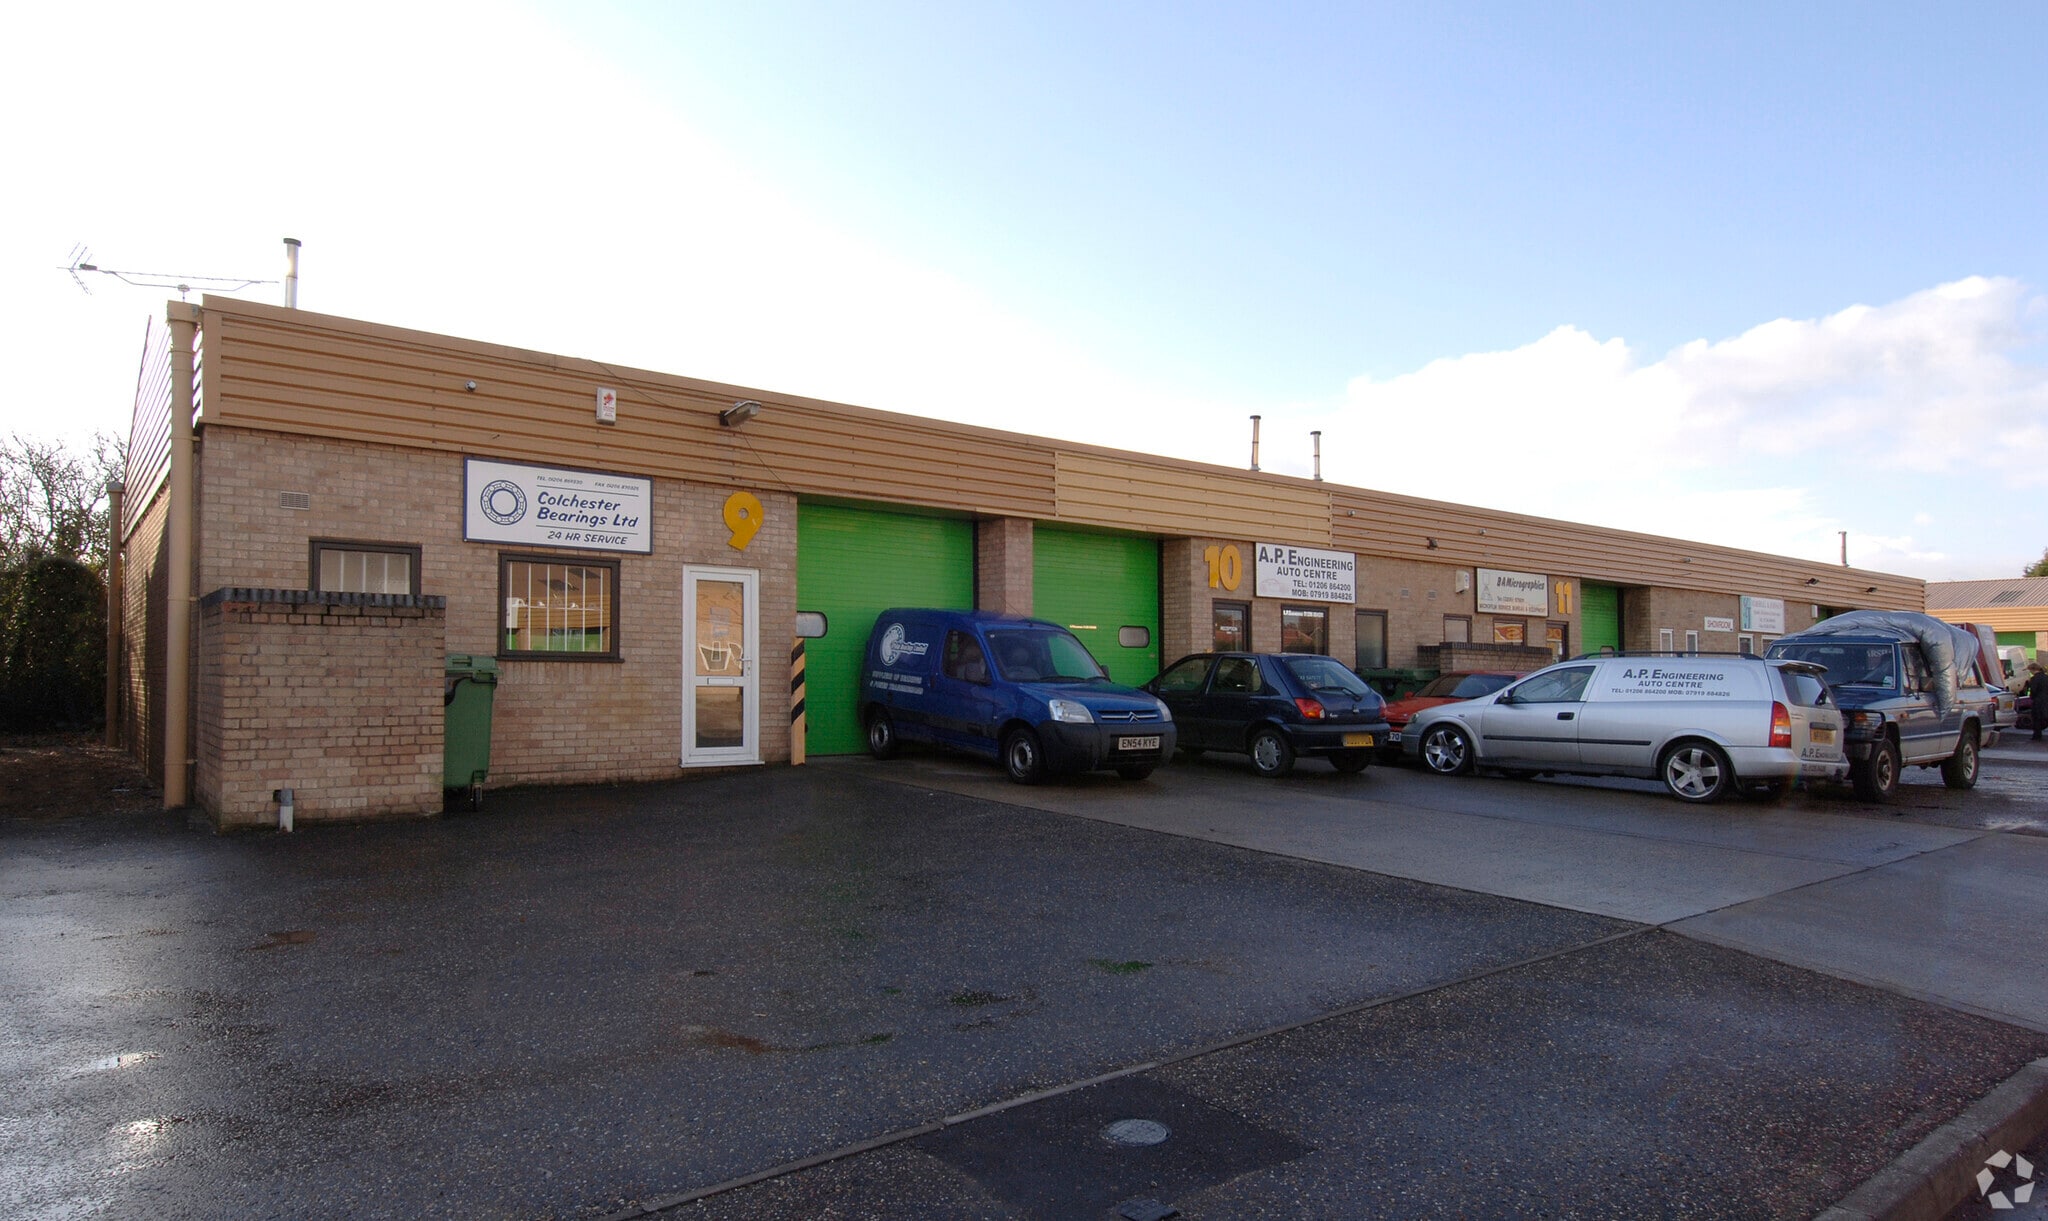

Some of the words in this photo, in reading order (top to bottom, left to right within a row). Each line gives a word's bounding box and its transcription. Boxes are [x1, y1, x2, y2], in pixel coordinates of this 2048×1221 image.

[538, 491, 620, 511] Colchester
[537, 506, 608, 528] Bearings
[613, 514, 639, 528] Ltd
[722, 490, 764, 551] 9
[547, 530, 562, 540] 24
[565, 532, 581, 541] HR
[583, 534, 628, 545] SERVICE
[1203, 544, 1242, 591] 10
[1276, 566, 1301, 577] AUTO
[1303, 569, 1337, 580] CENTRE
[1291, 588, 1309, 597] MOB:
[1310, 590, 1329, 599] 07919
[1293, 579, 1308, 588] TEL:
[1308, 581, 1328, 590] 01206
[1554, 581, 1573, 615] 11
